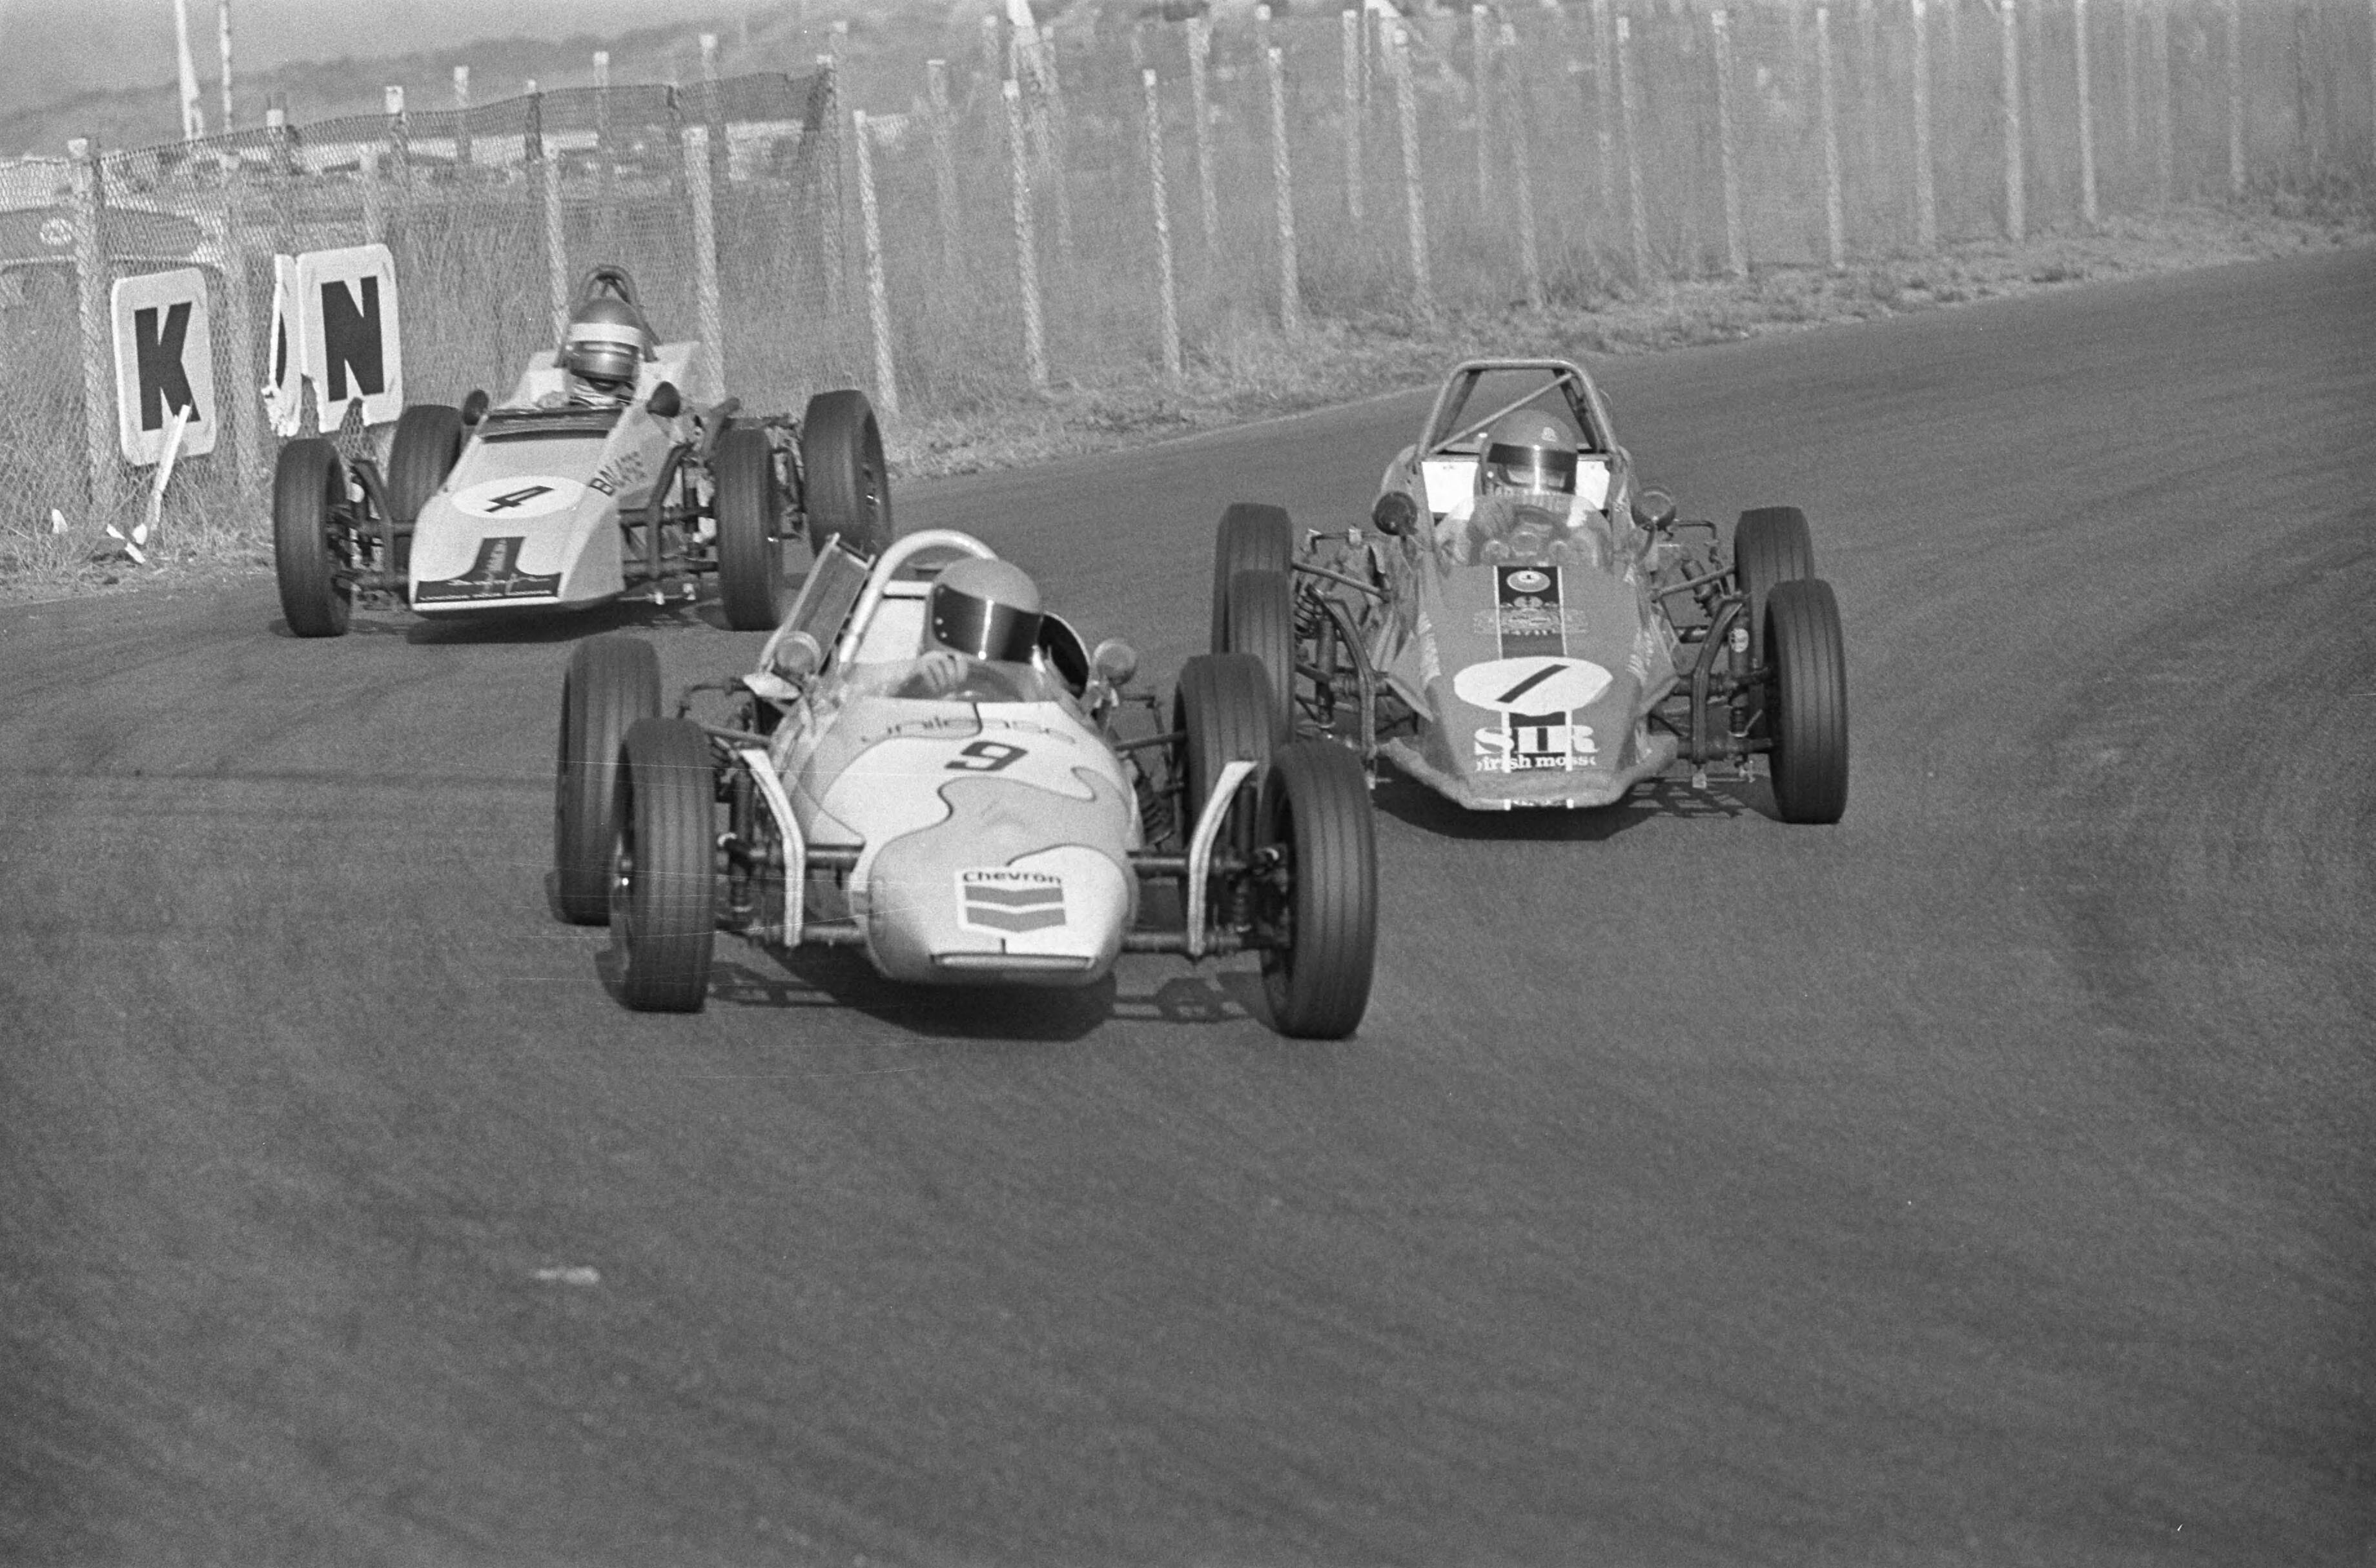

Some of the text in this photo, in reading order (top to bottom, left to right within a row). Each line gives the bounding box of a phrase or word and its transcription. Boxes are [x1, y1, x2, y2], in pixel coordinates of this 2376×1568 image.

[134, 301, 201, 431] K
[320, 276, 385, 402] N
[485, 484, 555, 513] 4
[1495, 663, 1572, 704] 1
[1474, 724, 1601, 755] SIR
[943, 741, 1029, 771] 9
[1483, 753, 1533, 771] irsh
[963, 871, 1061, 884] Chevron
